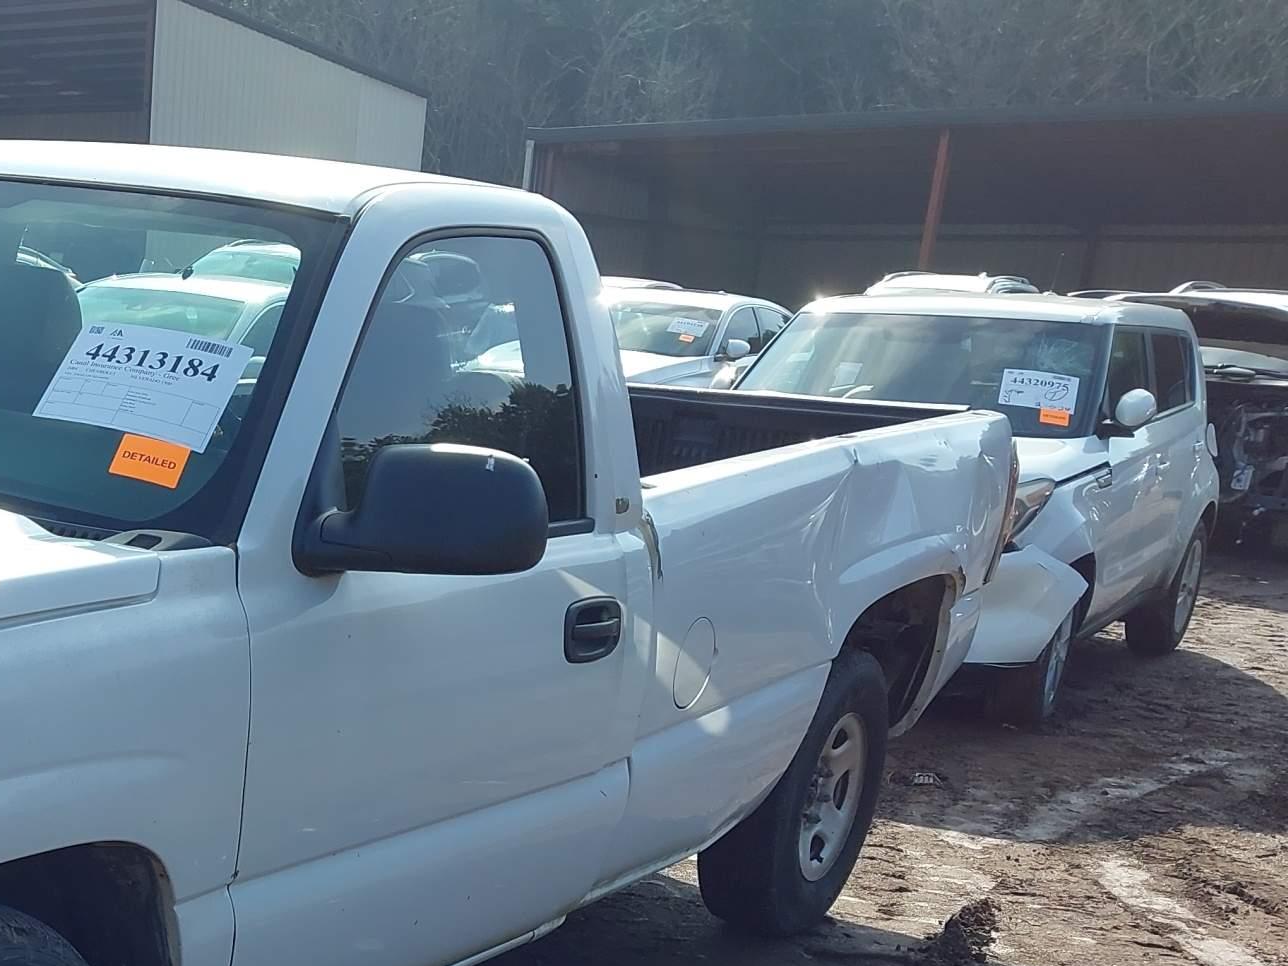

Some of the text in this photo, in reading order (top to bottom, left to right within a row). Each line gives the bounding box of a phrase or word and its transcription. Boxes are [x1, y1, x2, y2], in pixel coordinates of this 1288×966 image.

[85, 342, 220, 382] 44313184
[1011, 377, 1069, 391] 44320975
[121, 450, 177, 470] DETAILED
